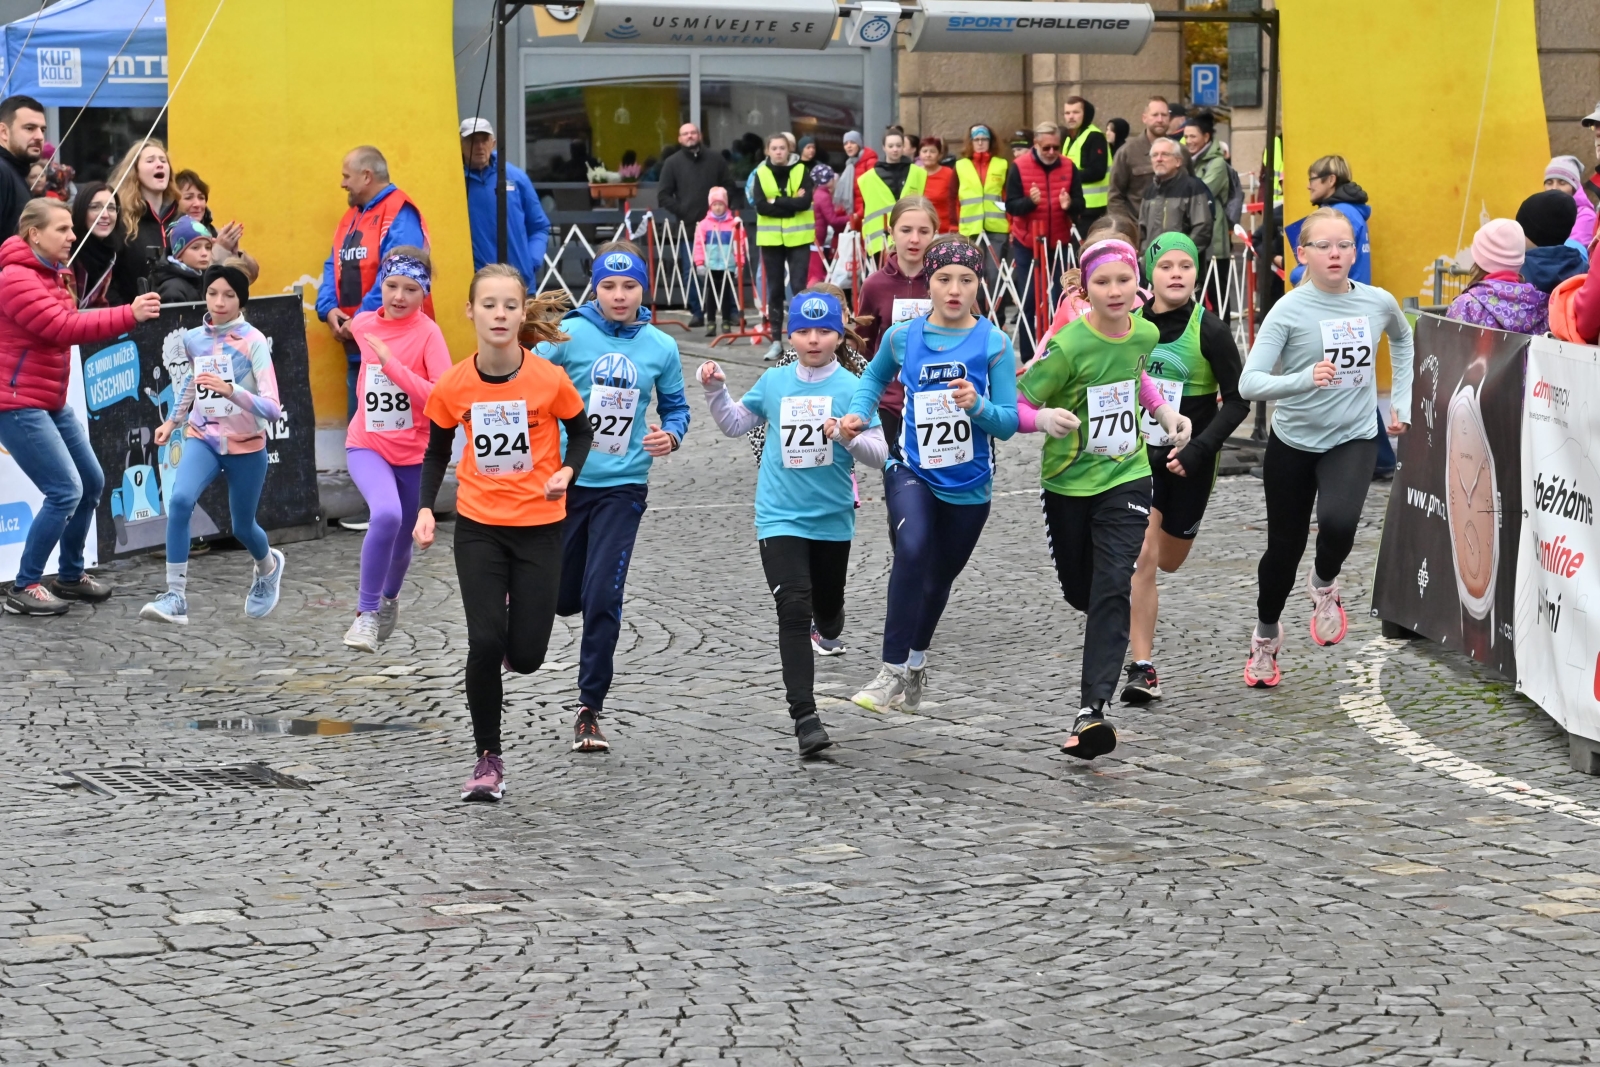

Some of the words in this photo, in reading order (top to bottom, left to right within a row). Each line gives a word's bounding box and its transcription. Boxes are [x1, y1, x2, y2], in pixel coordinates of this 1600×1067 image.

[652, 14, 778, 33] USMÍVEJTE
[789, 21, 816, 33] SE
[669, 33, 696, 42] NA
[703, 33, 777, 44] ANTÉNY
[40, 50, 72, 66] KUP
[41, 66, 73, 80] KOLO
[1197, 69, 1214, 93] P
[1324, 345, 1371, 369] 752
[86, 362, 96, 379] SE
[90, 367, 135, 406] VŠECHNO!
[365, 391, 410, 413] 938
[587, 413, 634, 437] 927
[781, 423, 828, 447] 721
[916, 419, 971, 447] 720
[1089, 409, 1134, 440] 770
[474, 431, 530, 458] 924
[1533, 472, 1594, 526] běháme
[1539, 534, 1585, 579] online
